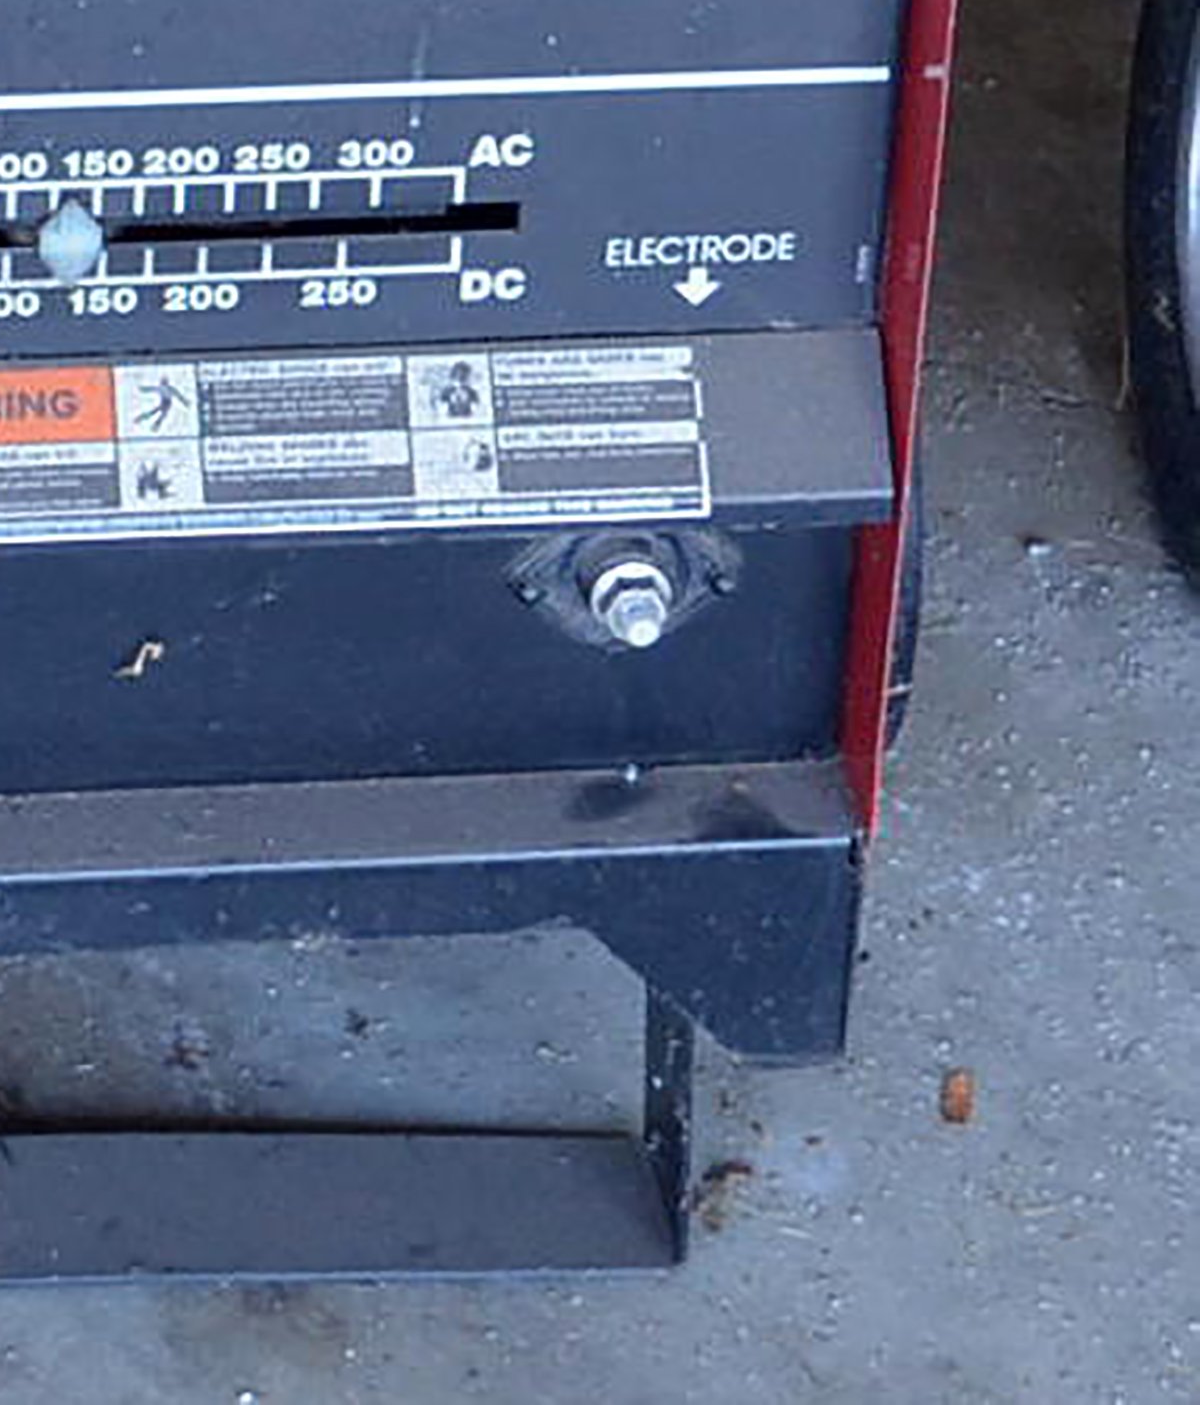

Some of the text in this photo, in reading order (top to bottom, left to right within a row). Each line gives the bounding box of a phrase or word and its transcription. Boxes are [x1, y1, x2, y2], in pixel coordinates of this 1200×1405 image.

[64, 150, 133, 177] 150
[144, 147, 220, 174] 200
[234, 144, 310, 170] 250
[338, 140, 414, 167] 300
[469, 135, 533, 168] AC
[604, 232, 796, 268] ELECTRODE
[70, 289, 137, 316] 150
[163, 284, 239, 311] 200
[300, 280, 377, 307] 250
[459, 269, 527, 301] DC
